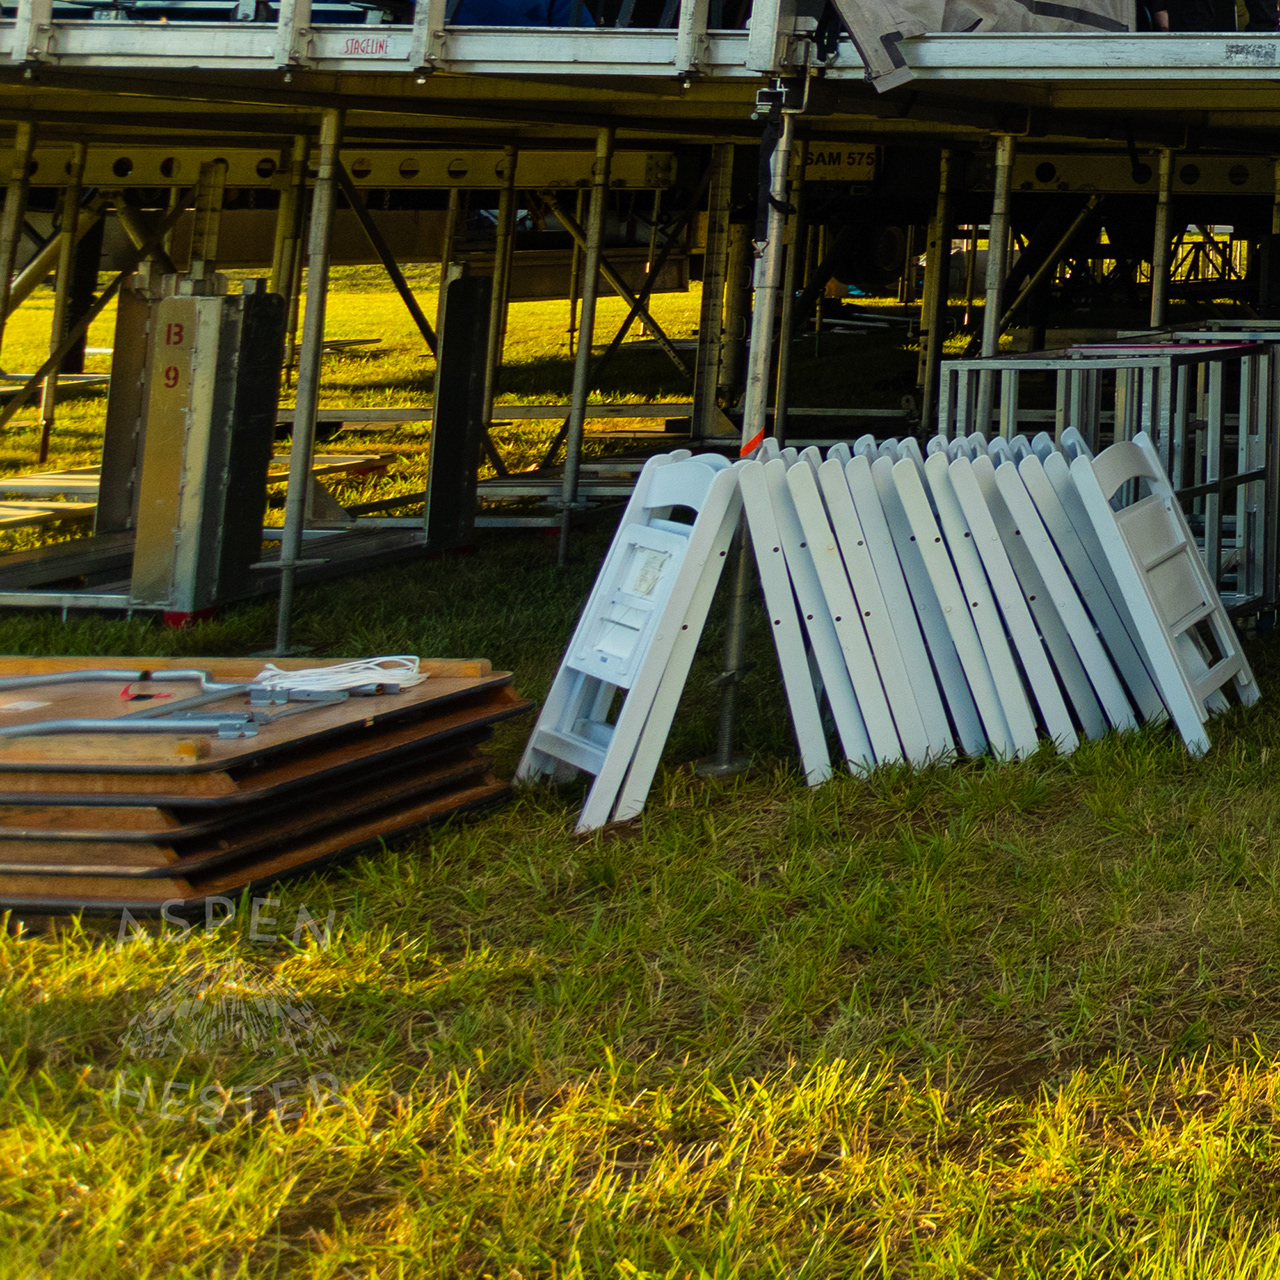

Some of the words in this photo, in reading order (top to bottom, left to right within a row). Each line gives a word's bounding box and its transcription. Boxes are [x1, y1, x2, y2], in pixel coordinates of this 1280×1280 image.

[344, 38, 389, 55] STAGELINE
[806, 151, 841, 166] SAM
[847, 152, 875, 166] 575
[164, 365, 179, 389] 9
